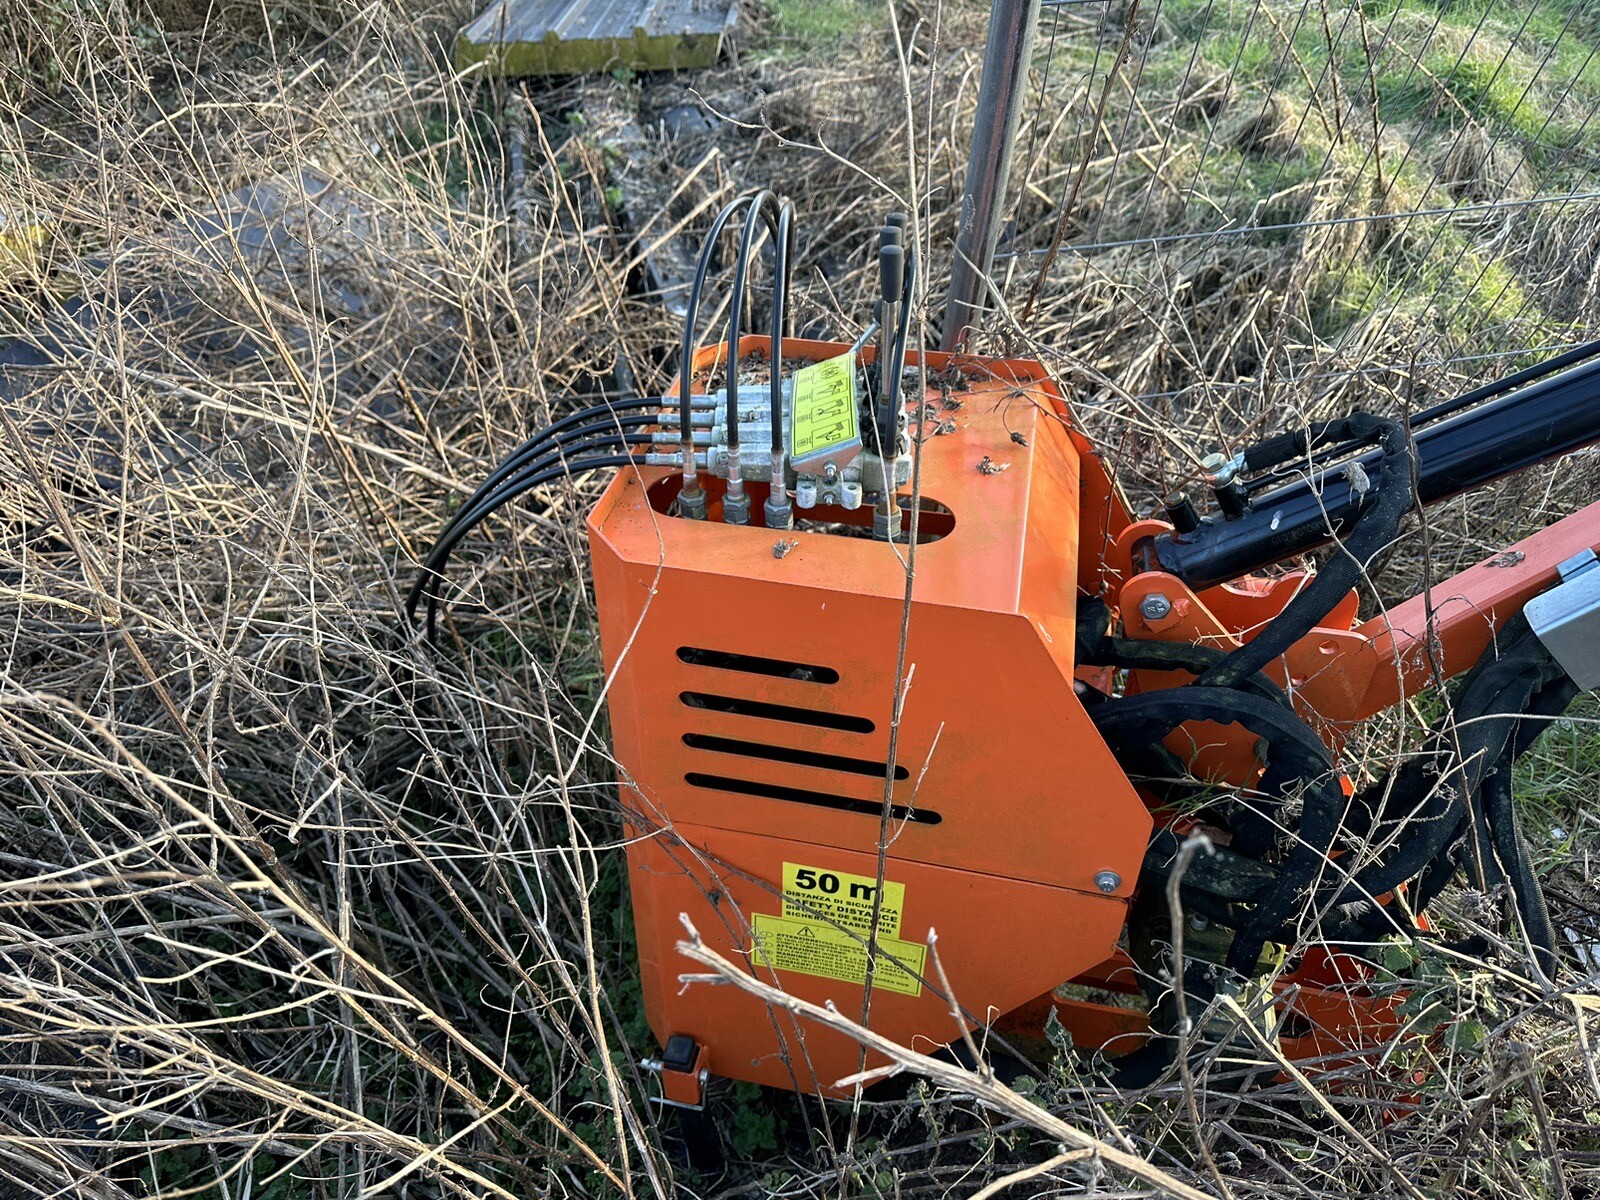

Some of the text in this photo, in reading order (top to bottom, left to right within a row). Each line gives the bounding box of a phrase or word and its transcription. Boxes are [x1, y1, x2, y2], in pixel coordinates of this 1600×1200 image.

[795, 868, 884, 903] 50 m
[786, 890, 831, 903] DISTANZA
[846, 901, 898, 915] SICURZZA
[787, 896, 832, 910] AFETY
